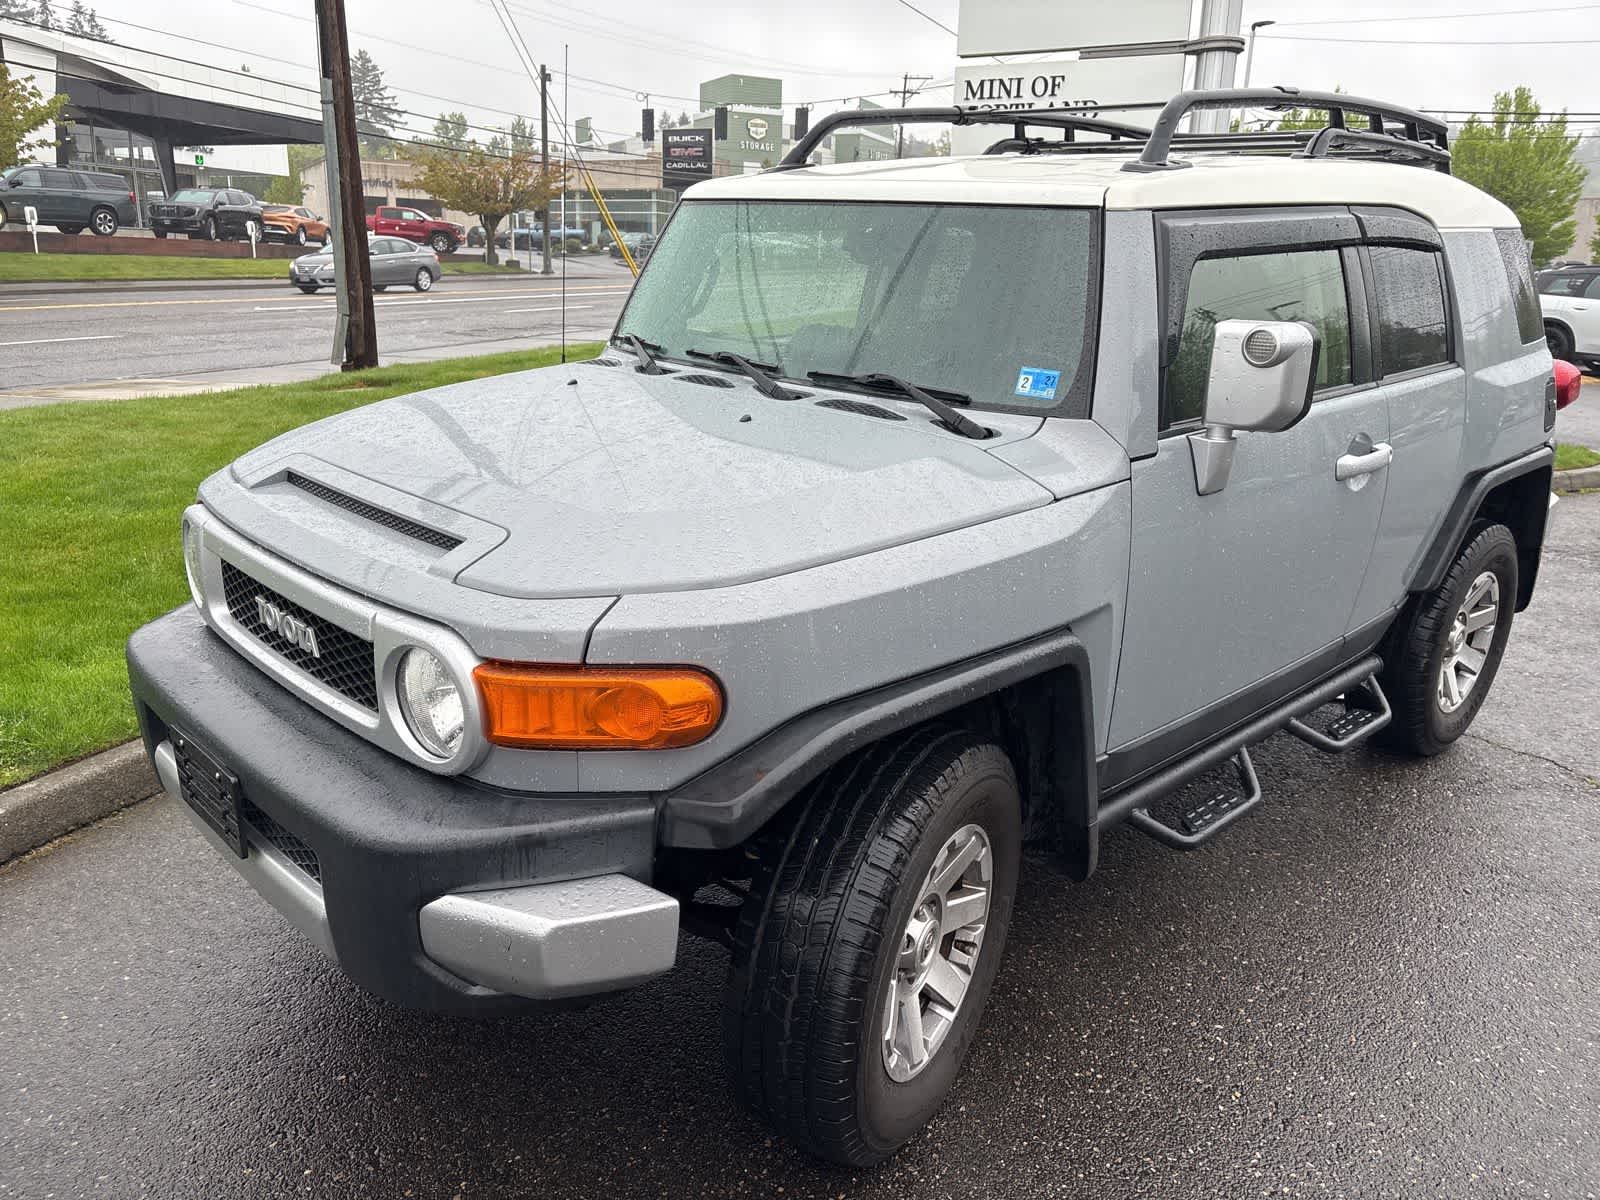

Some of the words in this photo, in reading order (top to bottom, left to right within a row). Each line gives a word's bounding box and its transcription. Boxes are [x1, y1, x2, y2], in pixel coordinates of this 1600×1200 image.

[964, 77, 1024, 100] MINI
[1031, 75, 1065, 98] OF
[670, 147, 703, 156] GMC
[739, 141, 775, 152] STORAGE
[1020, 376, 1030, 389] 2
[1044, 375, 1057, 387] 27
[254, 595, 321, 659] TOYOTA
